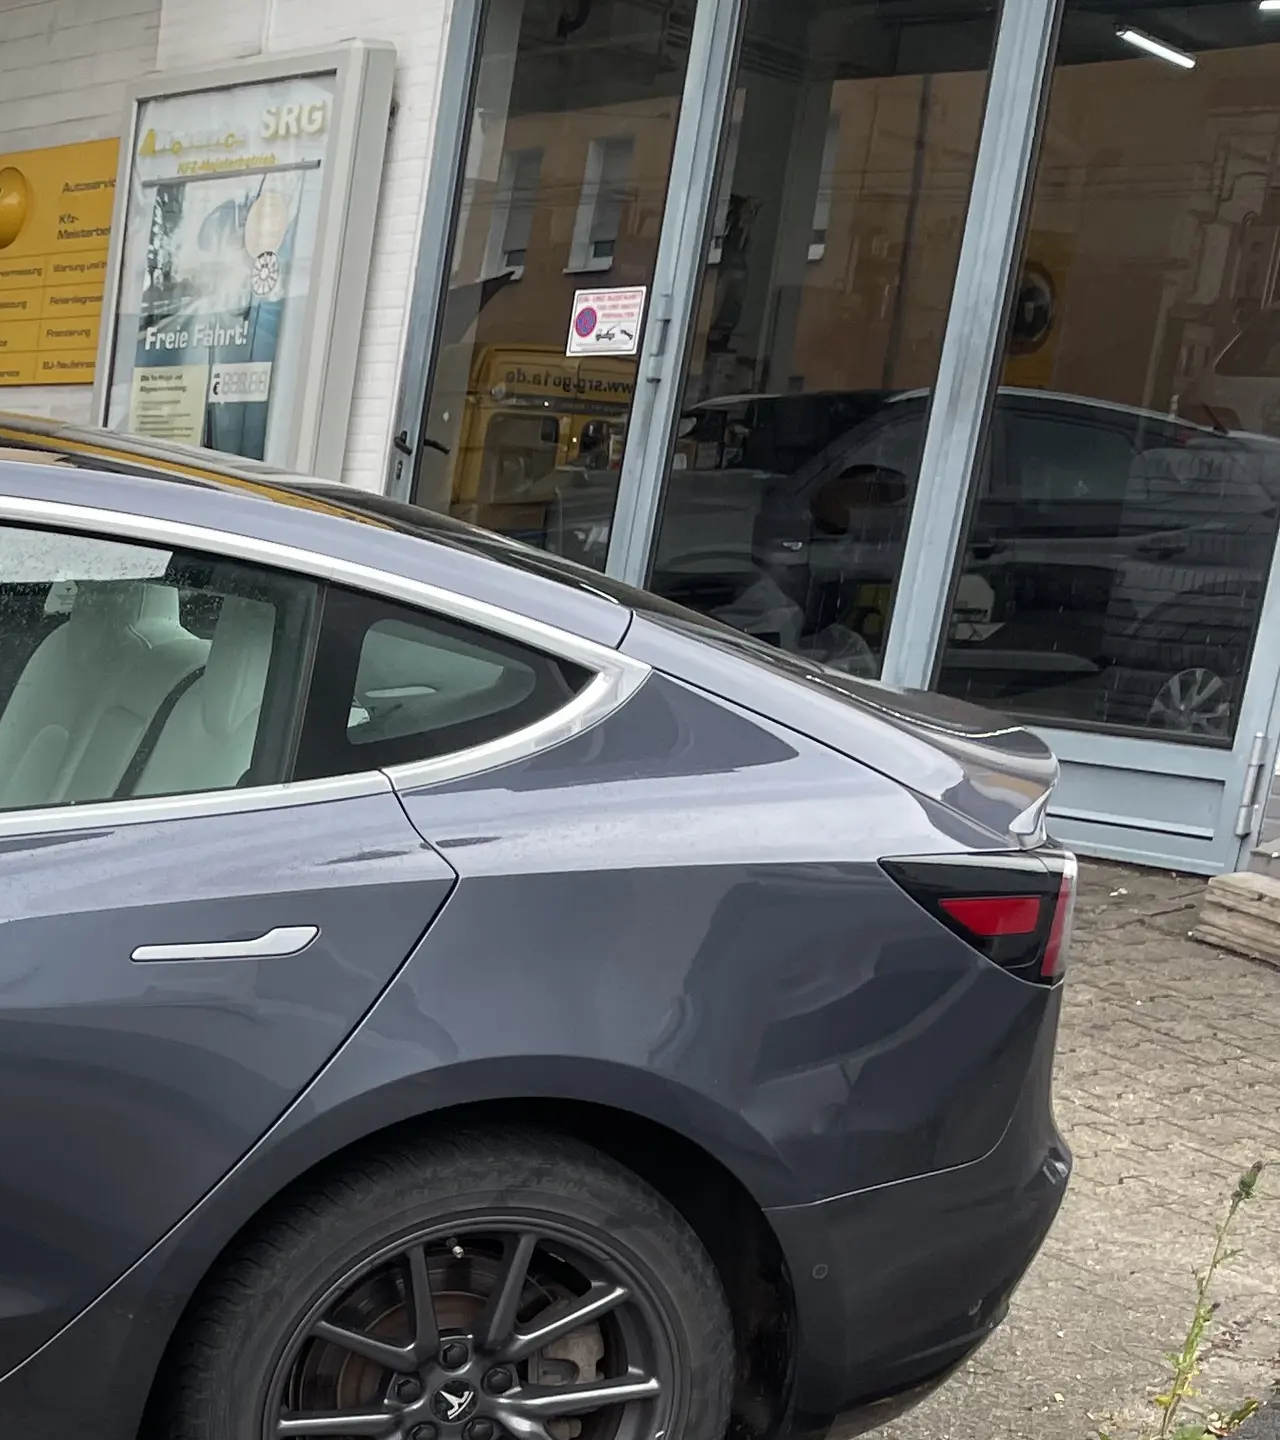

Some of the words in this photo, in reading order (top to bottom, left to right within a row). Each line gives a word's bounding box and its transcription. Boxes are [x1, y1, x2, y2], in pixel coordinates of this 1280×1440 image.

[261, 100, 327, 141] SRG
[144, 326, 189, 350] Freie
[193, 320, 250, 347] Fahrt!
